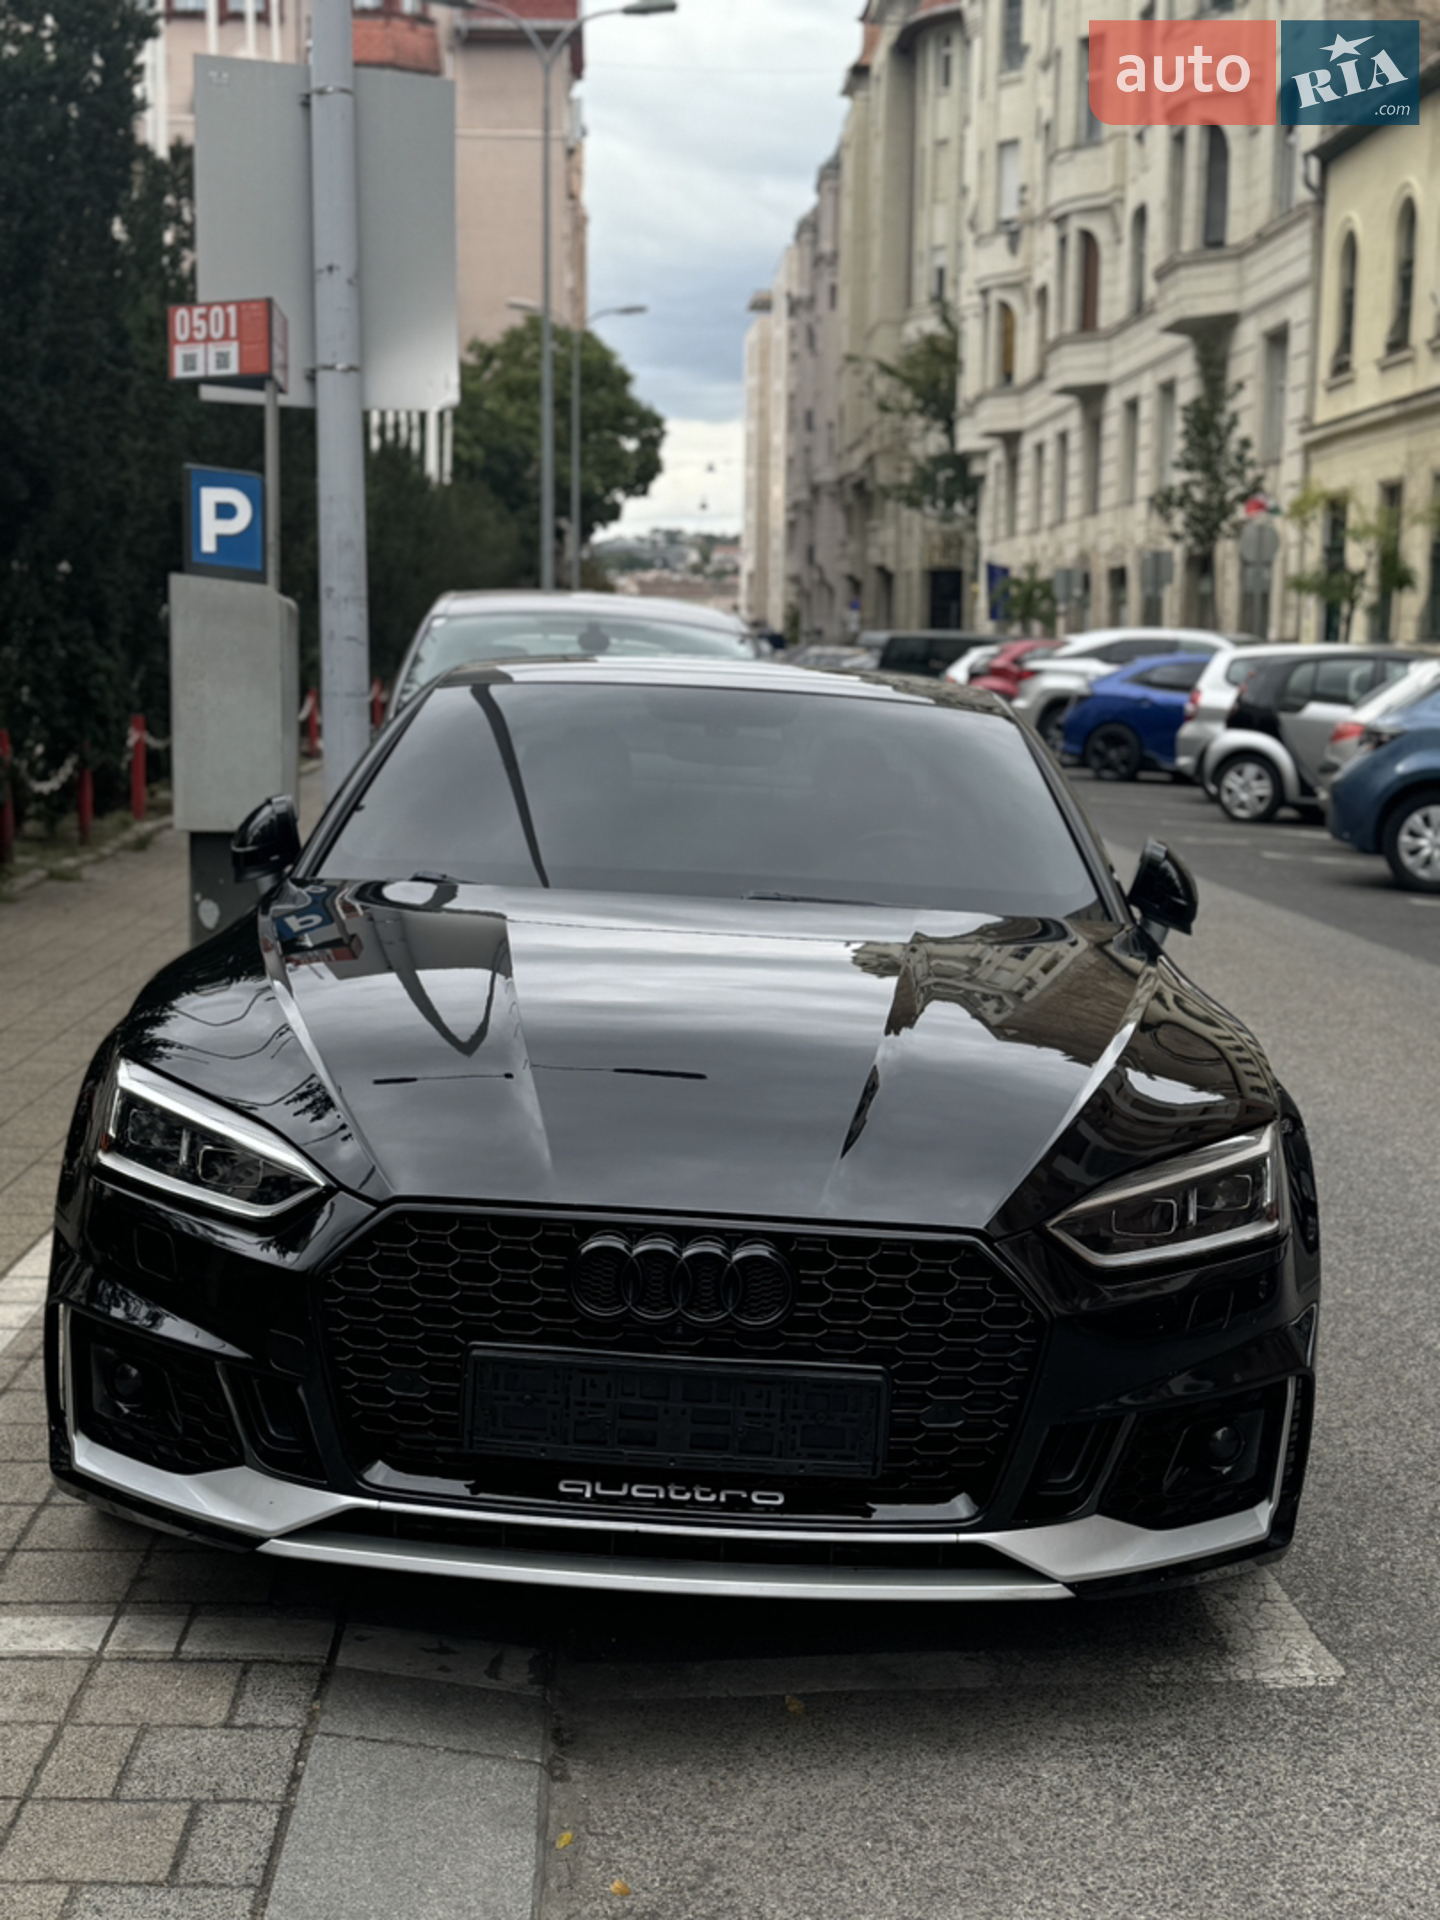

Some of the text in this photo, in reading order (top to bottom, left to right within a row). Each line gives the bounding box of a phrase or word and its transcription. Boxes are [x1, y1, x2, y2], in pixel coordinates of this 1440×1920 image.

[174, 304, 239, 342] 0501
[200, 486, 253, 554] P
[558, 1479, 785, 1506] quattro
